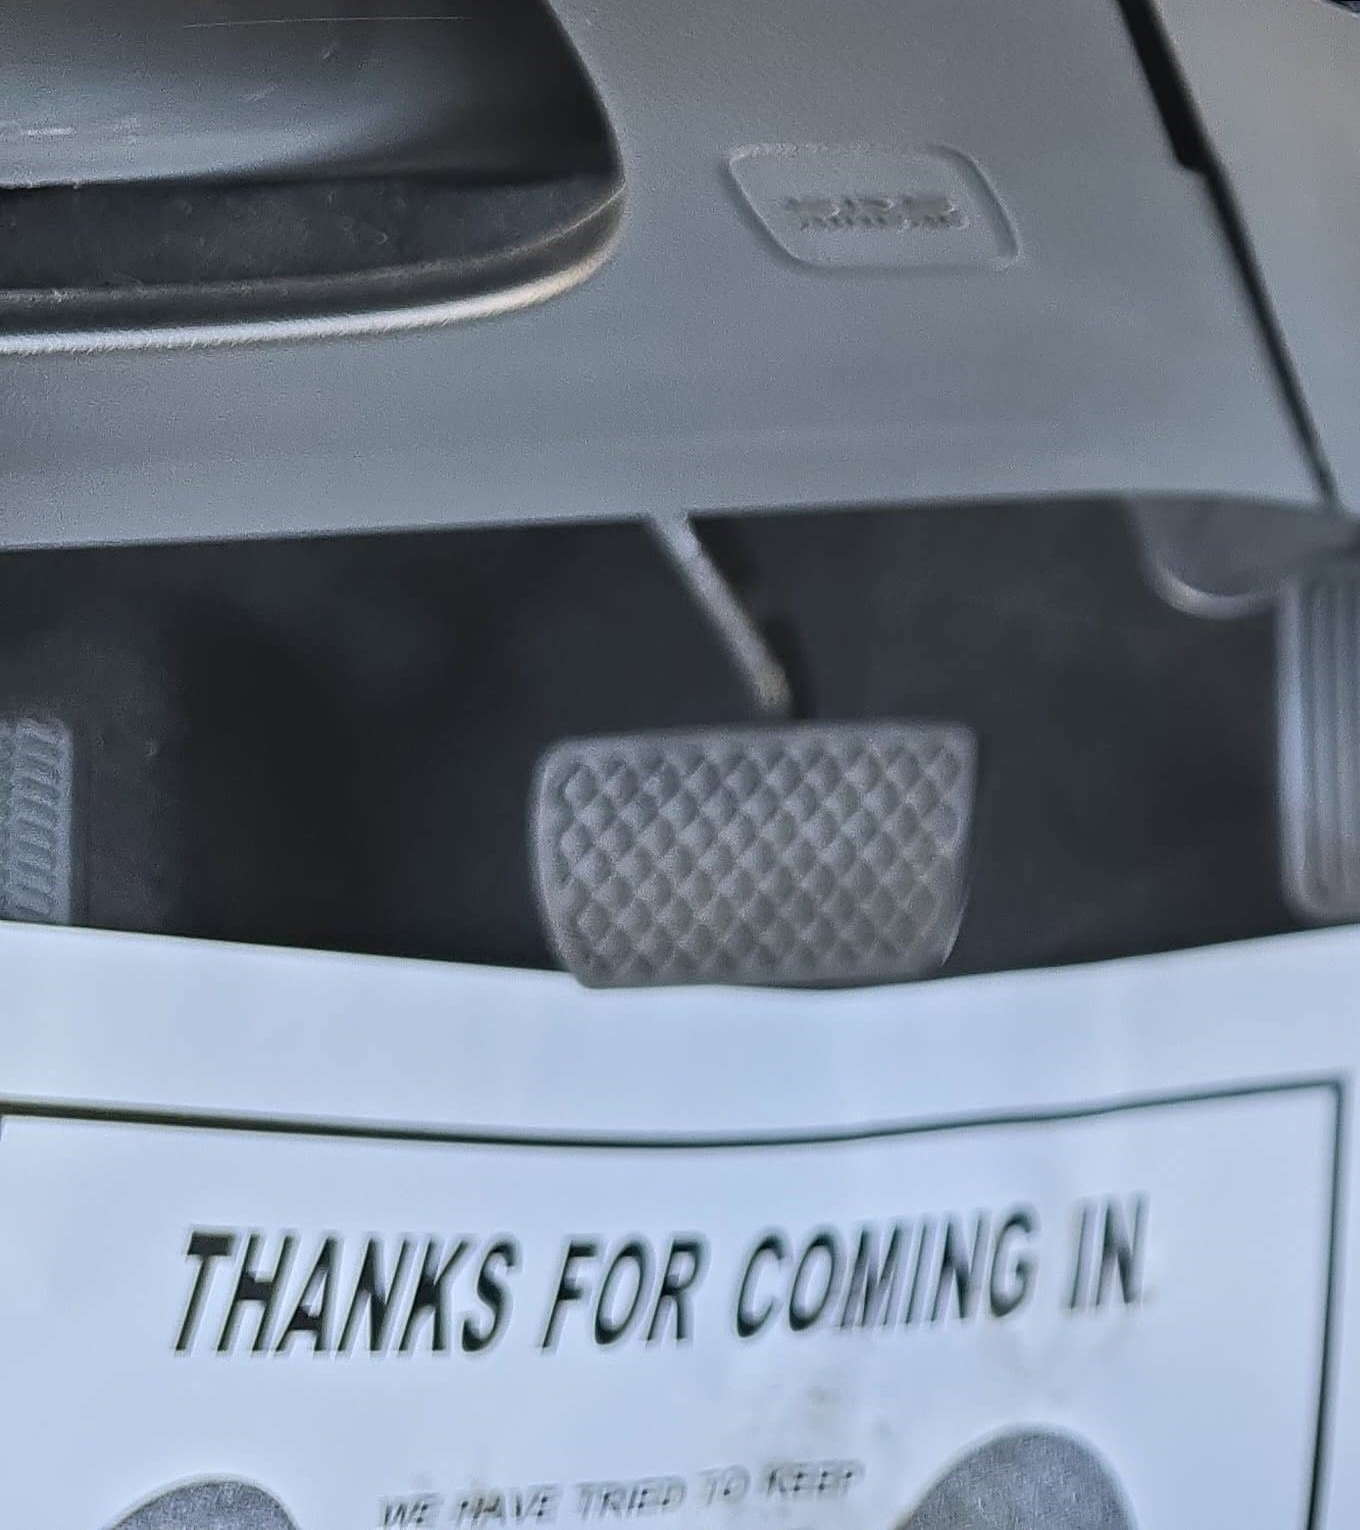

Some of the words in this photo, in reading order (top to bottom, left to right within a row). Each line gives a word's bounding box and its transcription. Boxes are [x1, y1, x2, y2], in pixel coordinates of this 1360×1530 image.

[172, 1228, 522, 1356] THANKS
[540, 1230, 710, 1352] FOR
[734, 1205, 1036, 1336] COMING
[698, 1464, 752, 1508] TO
